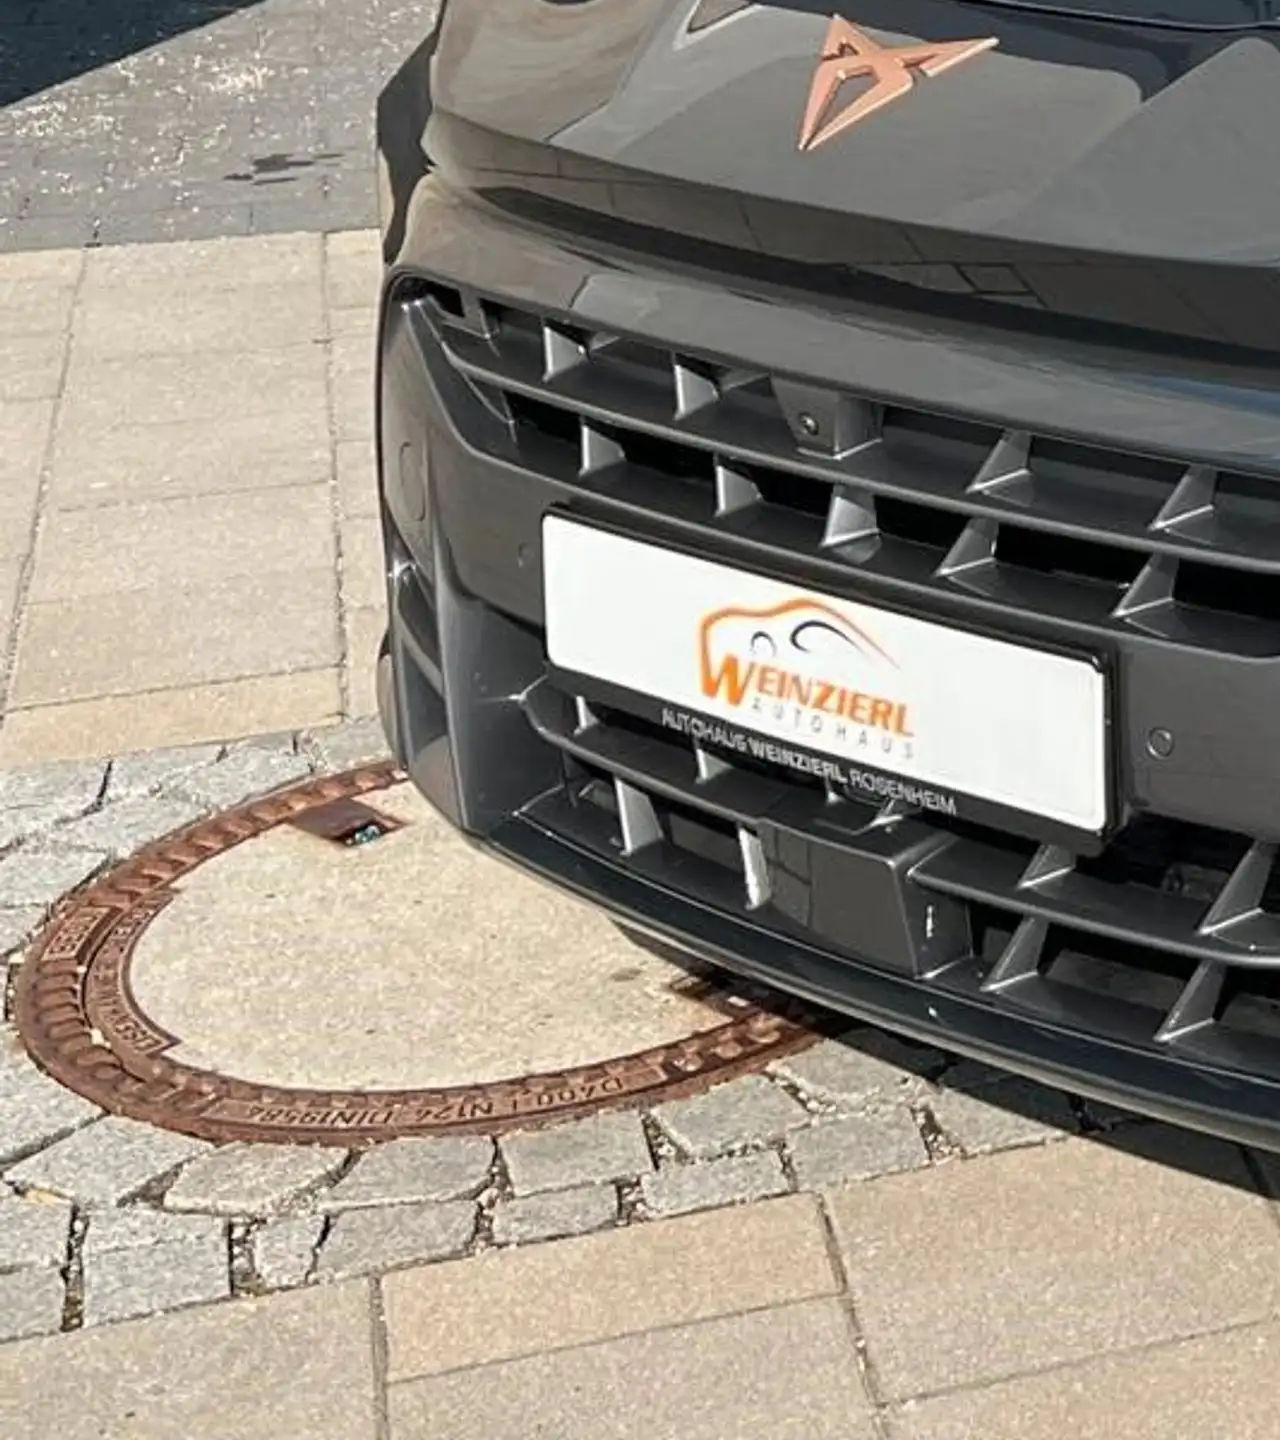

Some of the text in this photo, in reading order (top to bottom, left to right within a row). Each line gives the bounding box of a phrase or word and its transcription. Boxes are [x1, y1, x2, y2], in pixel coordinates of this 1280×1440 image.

[697, 654, 915, 738] WEINZIERL
[750, 698, 915, 760] AUTOHAUS
[661, 707, 958, 816] AUTOHAUS WEINZIERL ROSENHEIM
